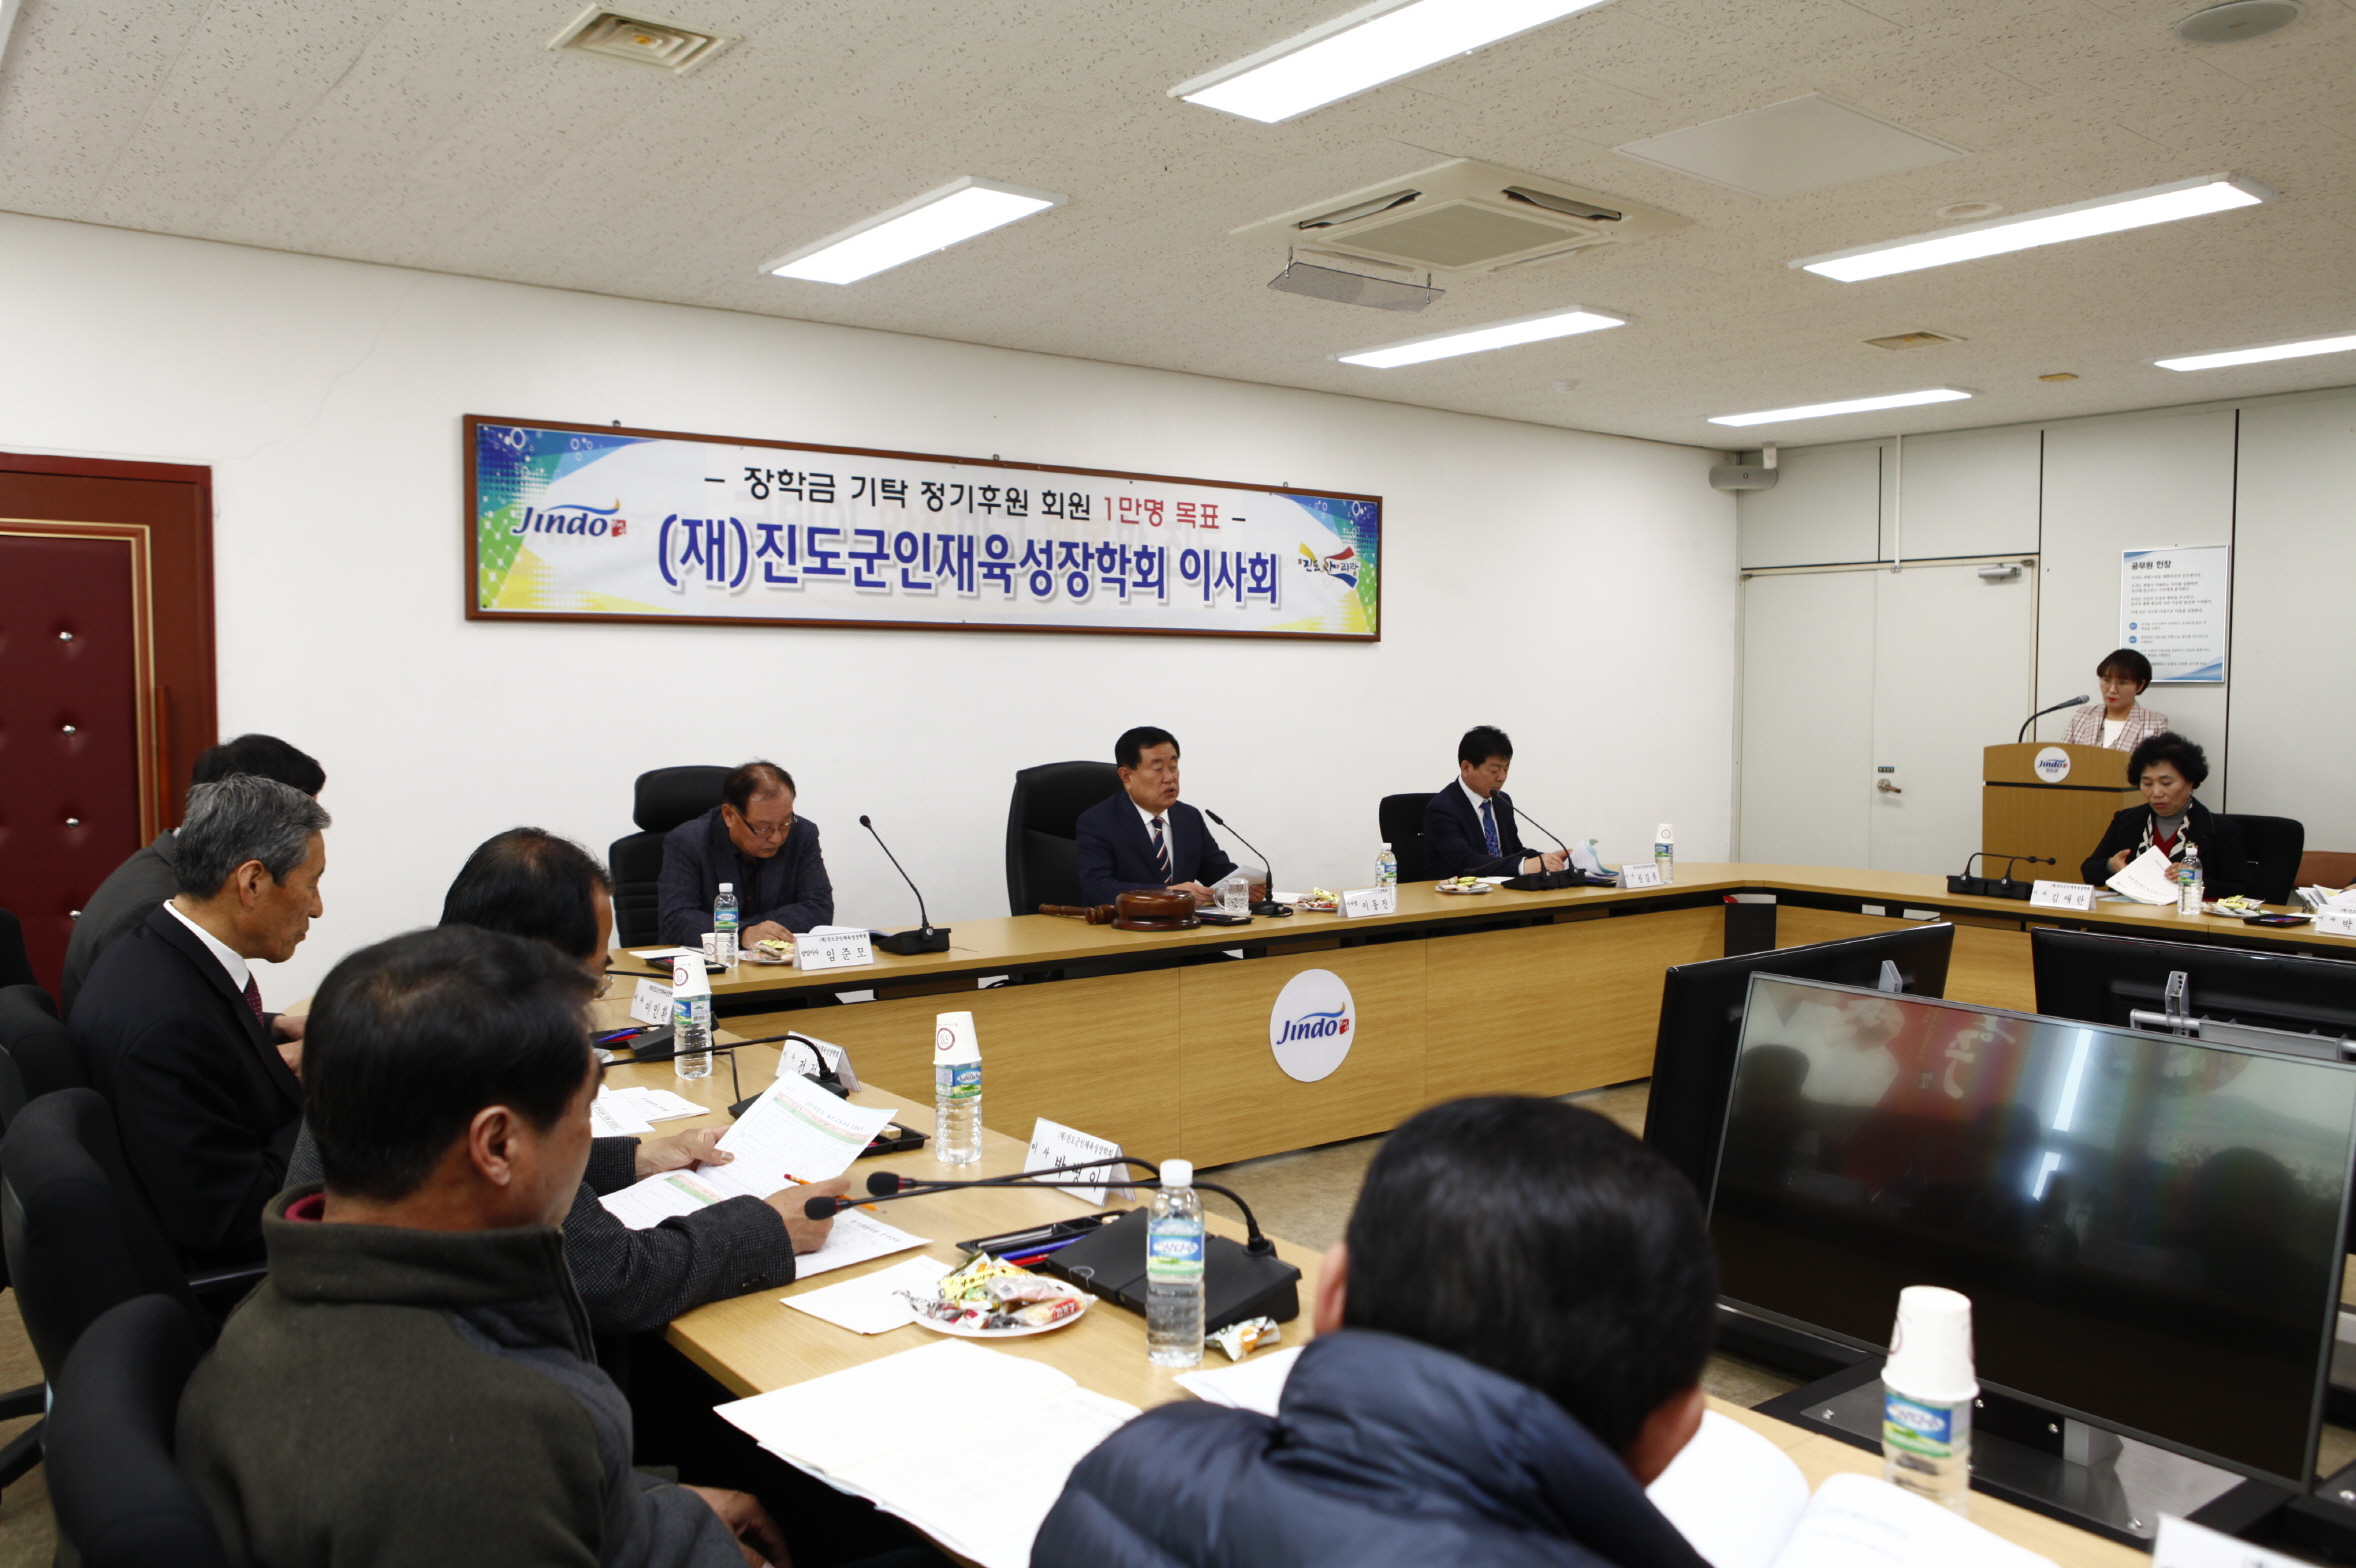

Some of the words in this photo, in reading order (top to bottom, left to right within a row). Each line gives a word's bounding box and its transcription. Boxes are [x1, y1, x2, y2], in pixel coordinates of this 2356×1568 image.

[744, 466, 836, 504] 장학금
[851, 475, 908, 509] 기탁
[920, 480, 1029, 517] 정기후원
[1041, 489, 1091, 521] 회원
[1104, 496, 1165, 527] 1만명
[1176, 501, 1221, 530] 목표
[511, 506, 608, 537] Jindo
[658, 513, 1166, 600] (재)진도군인재육성장학회
[1179, 547, 1277, 605] 이사회
[2037, 760, 2063, 769] Jindo
[1276, 1017, 1338, 1045] Jindo
